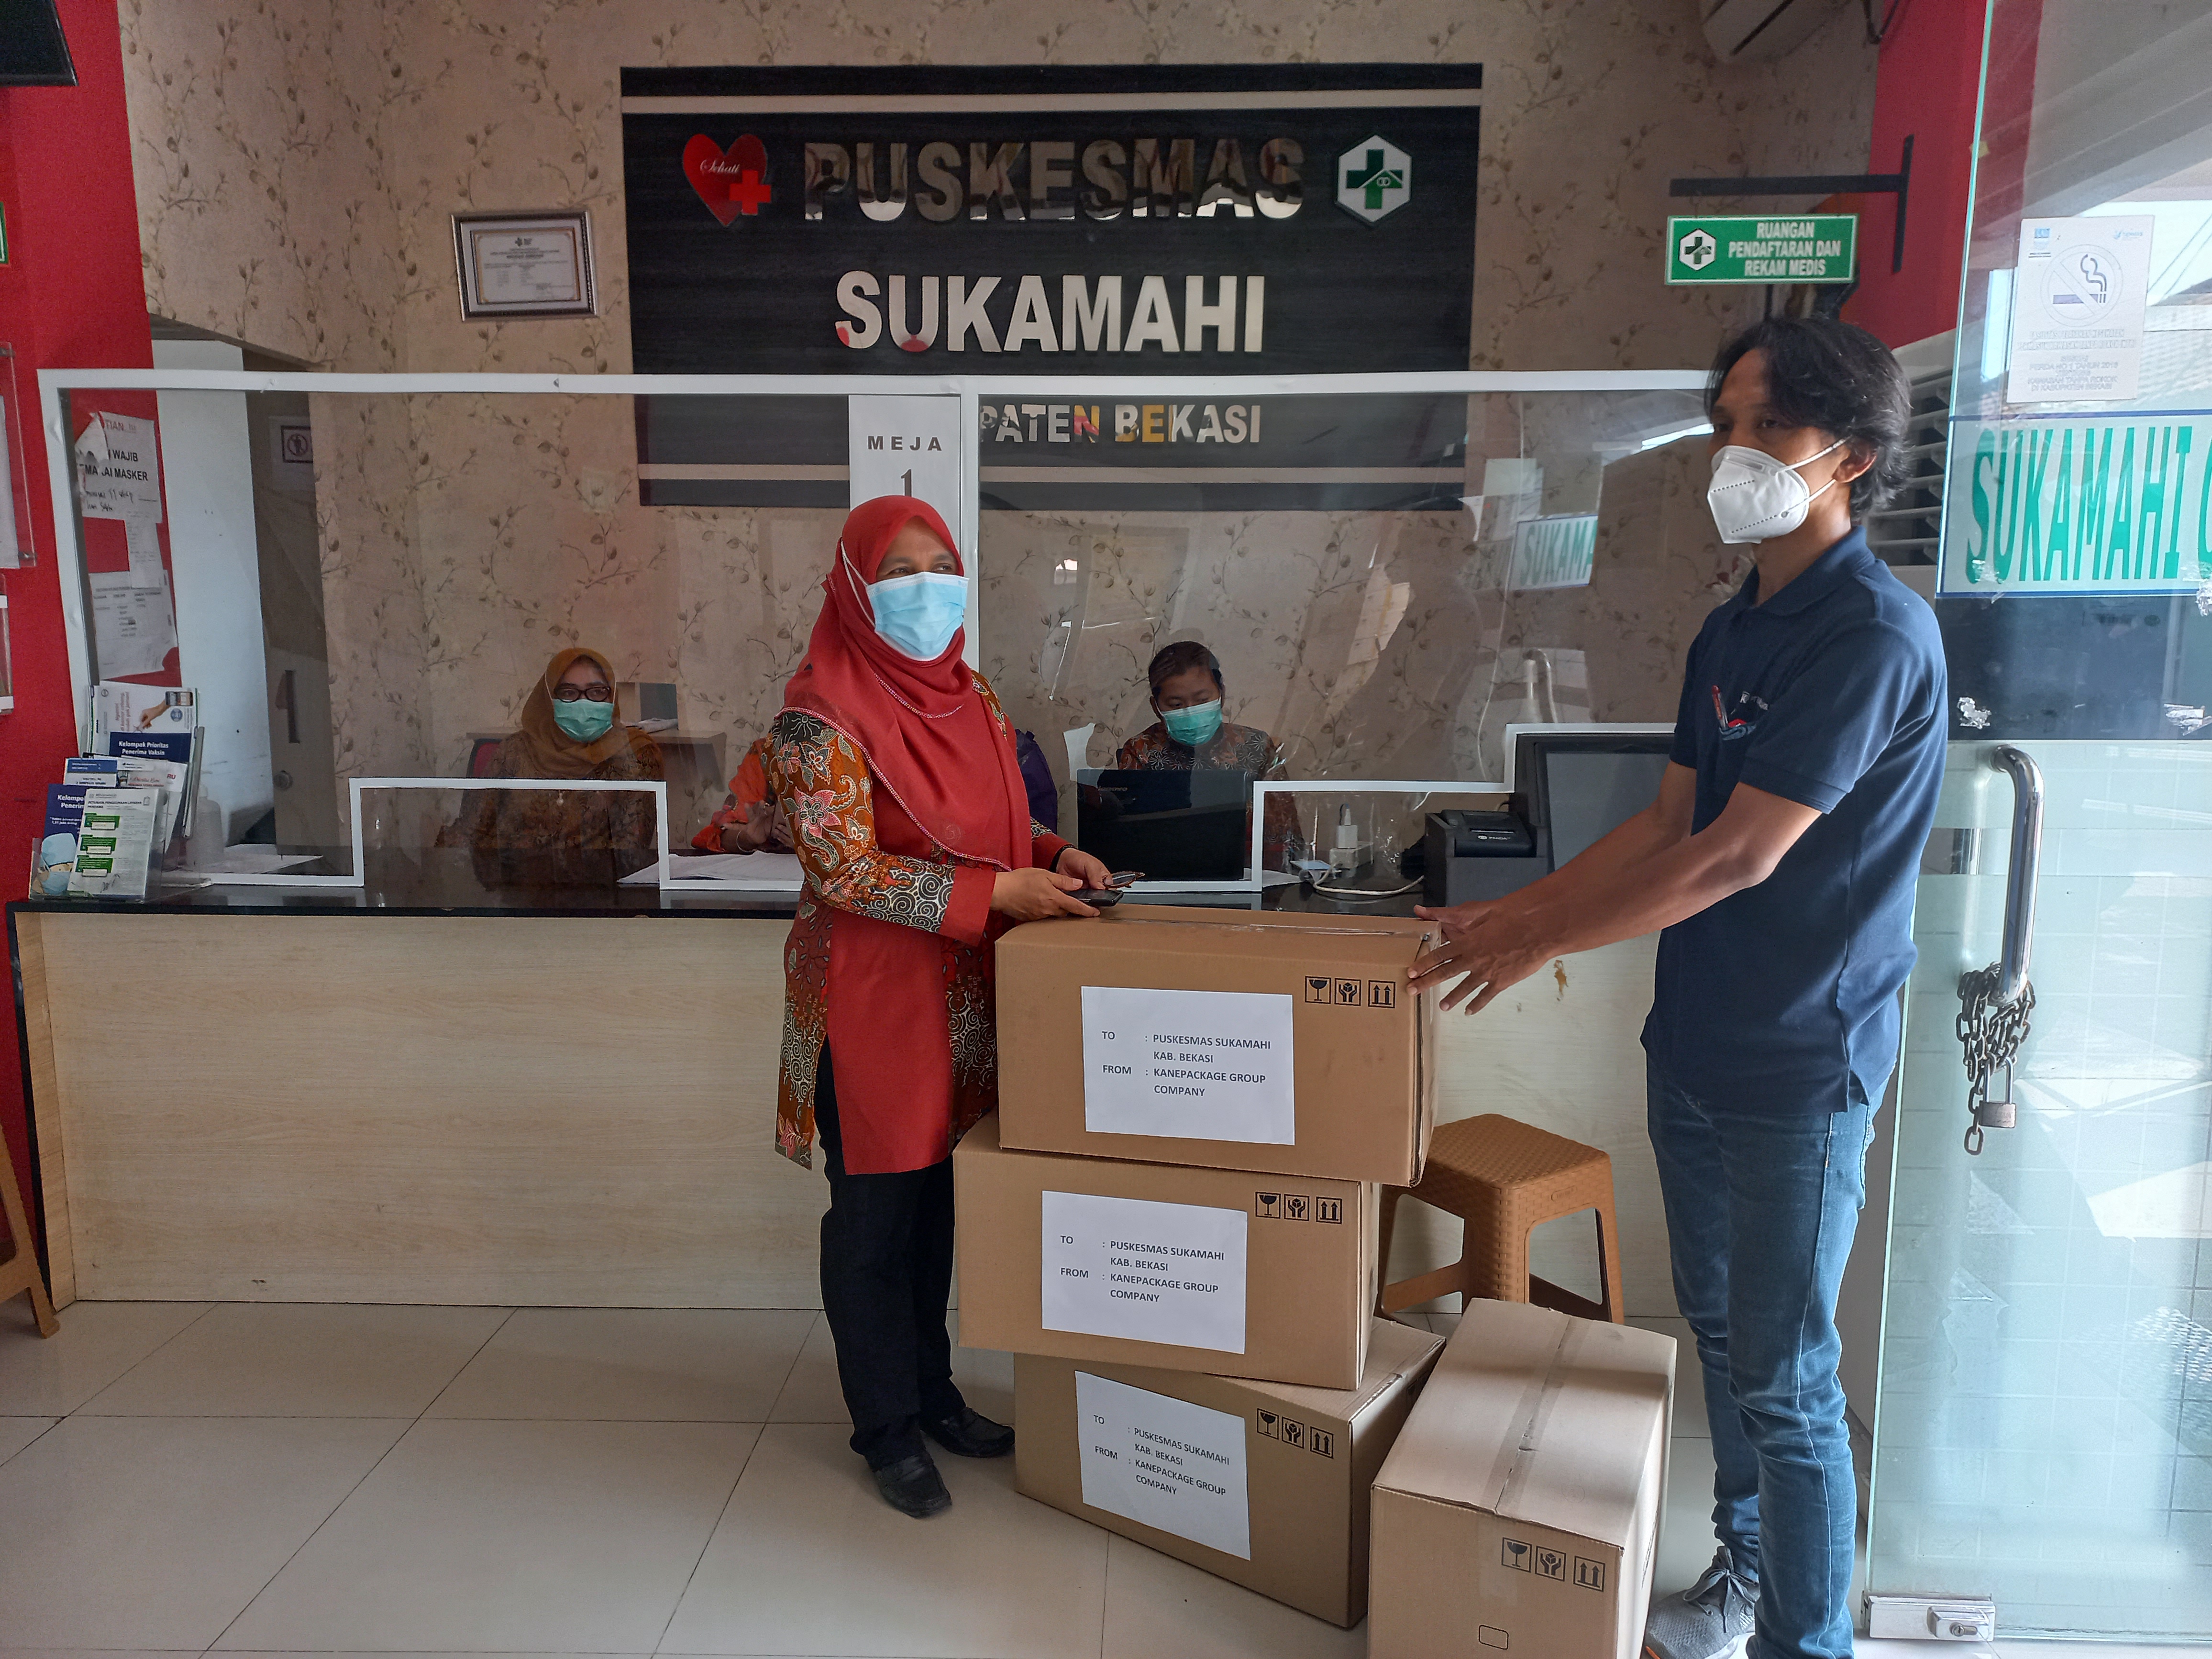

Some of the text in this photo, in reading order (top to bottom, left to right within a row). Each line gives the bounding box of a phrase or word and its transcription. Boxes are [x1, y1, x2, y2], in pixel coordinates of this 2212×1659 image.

[804, 138, 1305, 221] PUSKESMAS
[1757, 222, 1814, 239] RUANGAN
[1728, 240, 1841, 258] PENDAFTARAN DAN
[1744, 259, 1826, 276] REKAM MEDIS
[835, 270, 1264, 352] SUKAMAHI
[980, 405, 1261, 443] PATEN BEKASI
[868, 436, 941, 451] MEJA
[112, 449, 138, 462] WAJIB
[114, 468, 148, 481] MASKER
[1966, 426, 2192, 584] SUKAMAHI
[1102, 1031, 1115, 1040] TO
[1153, 1035, 1213, 1046] PUSKESMAS
[1215, 1038, 1271, 1050] SUKAMAHI
[1153, 1052, 1213, 1063] KAB. BEKASI
[1103, 1065, 1131, 1074] FROM
[1153, 1068, 1227, 1081] KANEPACKAGE
[1230, 1073, 1265, 1083] GROUP
[1154, 1085, 1205, 1096] COMPANY
[1061, 1236, 1073, 1244] TO
[1110, 1241, 1168, 1255] PUSKESMAS
[1171, 1248, 1224, 1261] SUKAMAHI
[1110, 1258, 1168, 1271] KAB. BEKASI
[1061, 1268, 1088, 1278] FROM
[1110, 1273, 1180, 1289] KANEPACKAGE
[1183, 1281, 1218, 1293] GROUP
[1110, 1289, 1159, 1303] COMPANY
[1094, 1415, 1104, 1424] TO
[1134, 1427, 1182, 1449] PUSKESMAS
[1184, 1443, 1229, 1465] SUKAMAHI
[1135, 1443, 1183, 1465] KAB. BEKASI
[1095, 1446, 1117, 1460] FROM
[1135, 1459, 1194, 1485] KANEPACKAGE
[1196, 1479, 1226, 1496] GROUP
[1136, 1475, 1176, 1495] COMPANY
